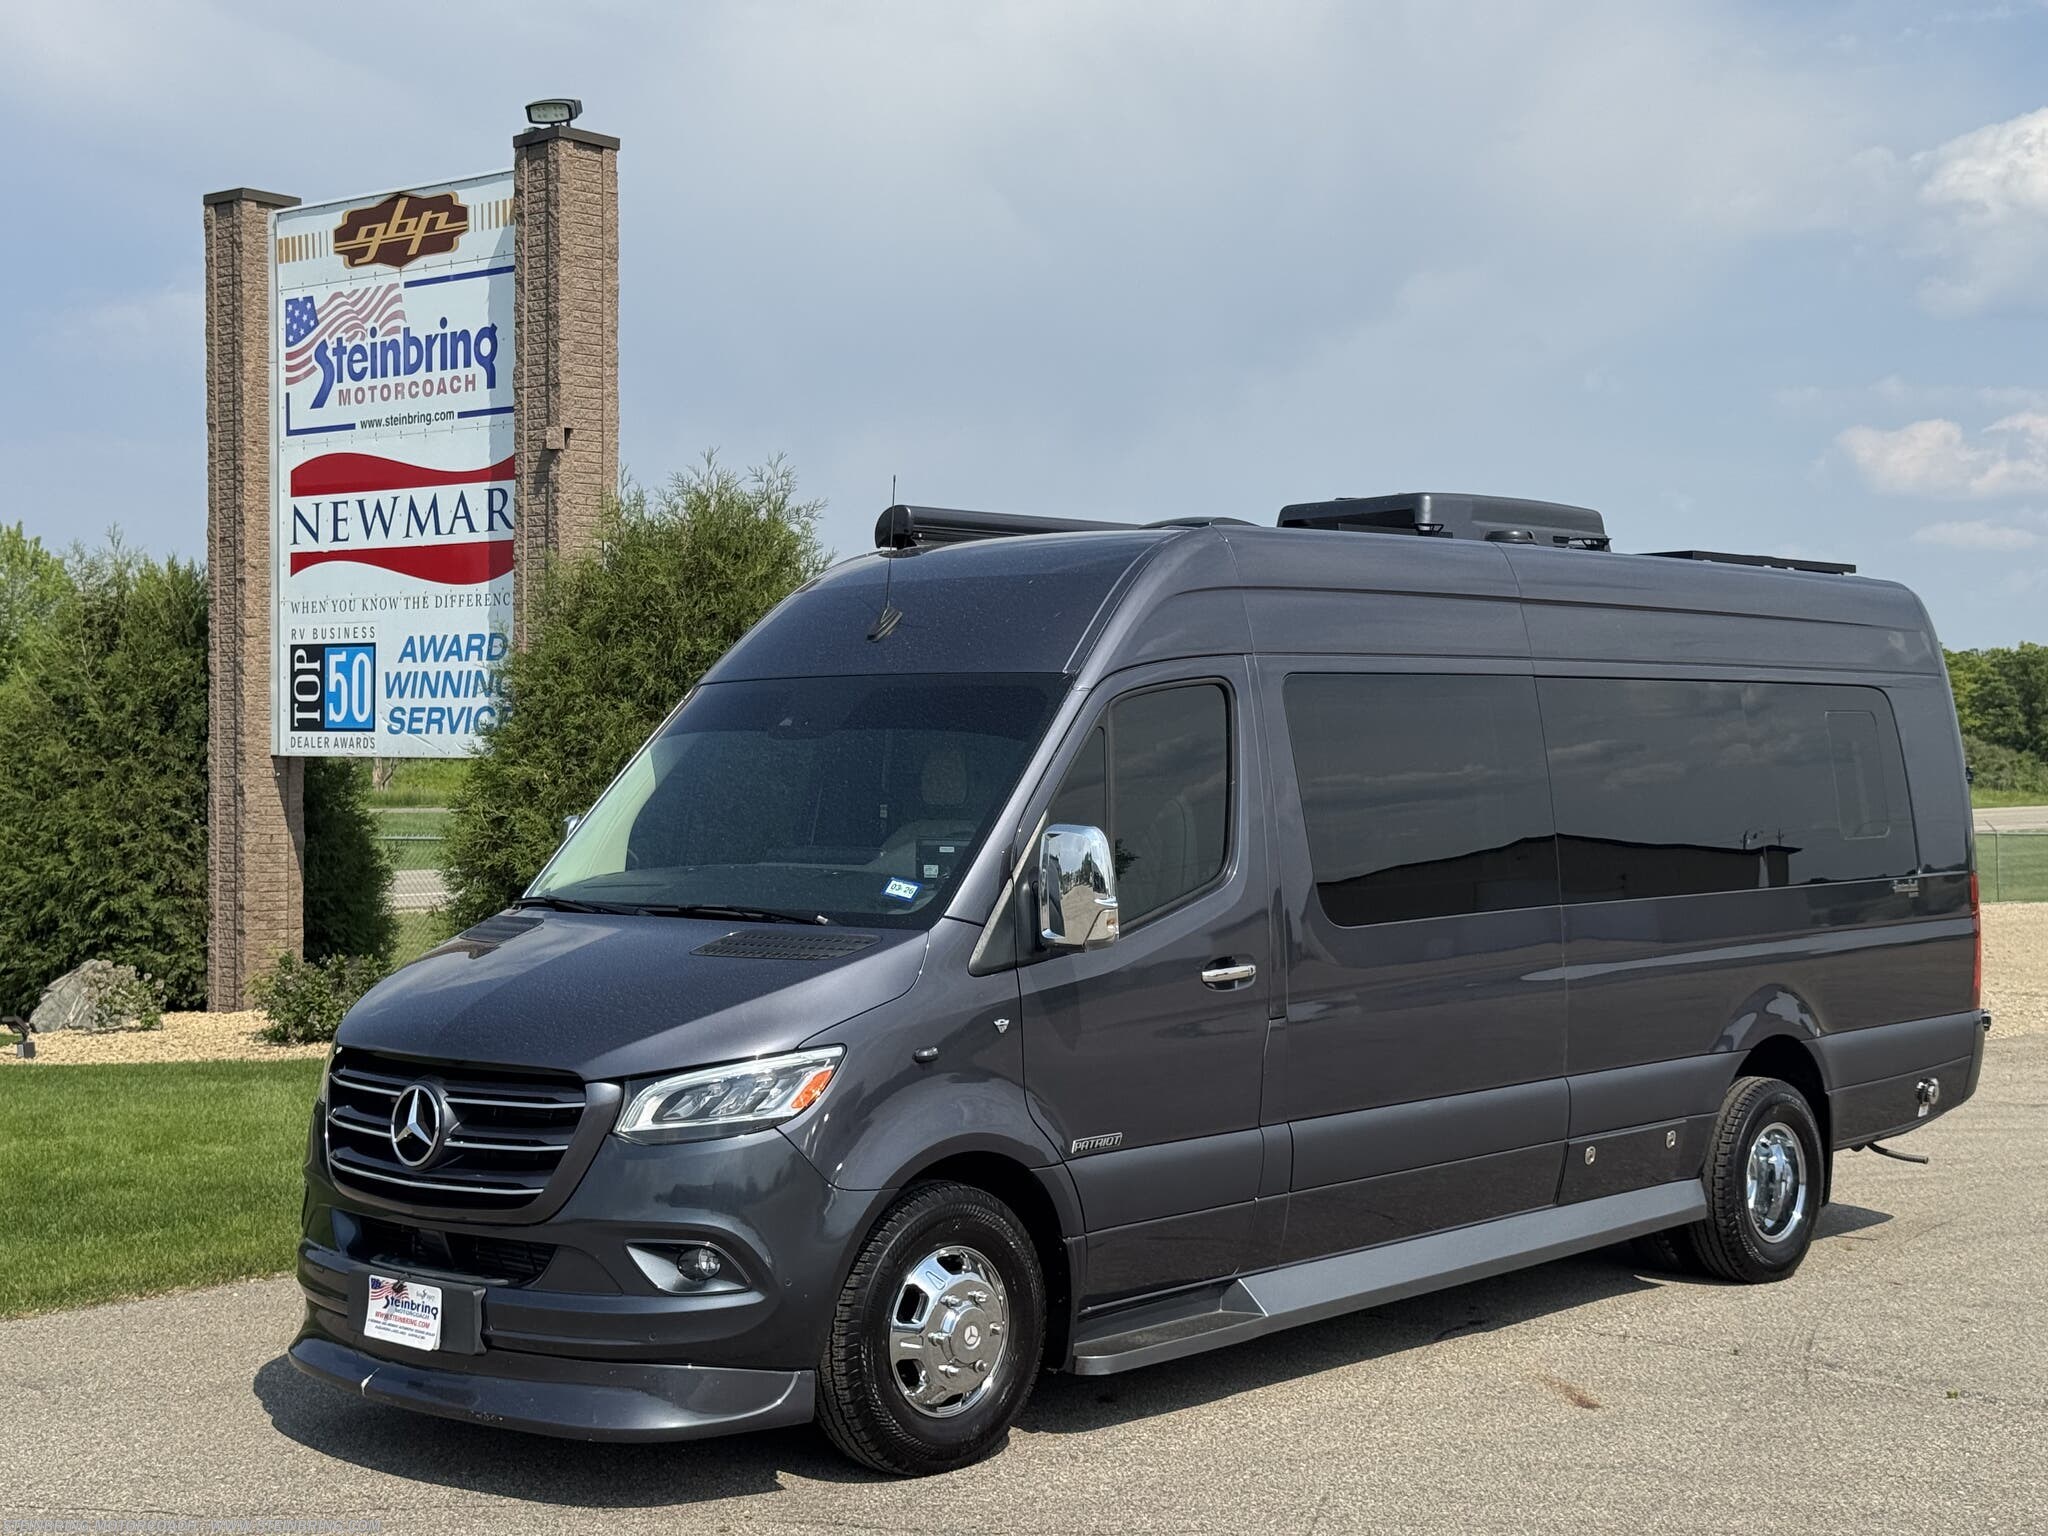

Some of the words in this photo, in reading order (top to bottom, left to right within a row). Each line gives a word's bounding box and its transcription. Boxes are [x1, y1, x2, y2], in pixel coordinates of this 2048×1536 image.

[309, 317, 498, 410] Steinbring
[338, 374, 477, 407] MOTORCOACH
[360, 410, 455, 431] www.steinbring.com
[290, 487, 514, 546] NEWMAR
[290, 600, 327, 614] WHEN
[331, 598, 357, 613] YOU
[361, 597, 399, 612] KNOW
[404, 596, 429, 610] THE
[434, 592, 514, 608] DIFFERENC
[291, 628, 305, 640] RV
[312, 626, 376, 640] BUSINESS
[397, 632, 509, 664] AWARD
[294, 648, 321, 727] TOP
[328, 650, 372, 723] 50
[290, 736, 330, 749] DEALER
[333, 736, 376, 749] AWARDS
[1074, 1135, 1121, 1152] PATRIOT
[382, 1295, 439, 1320] Steinbring
